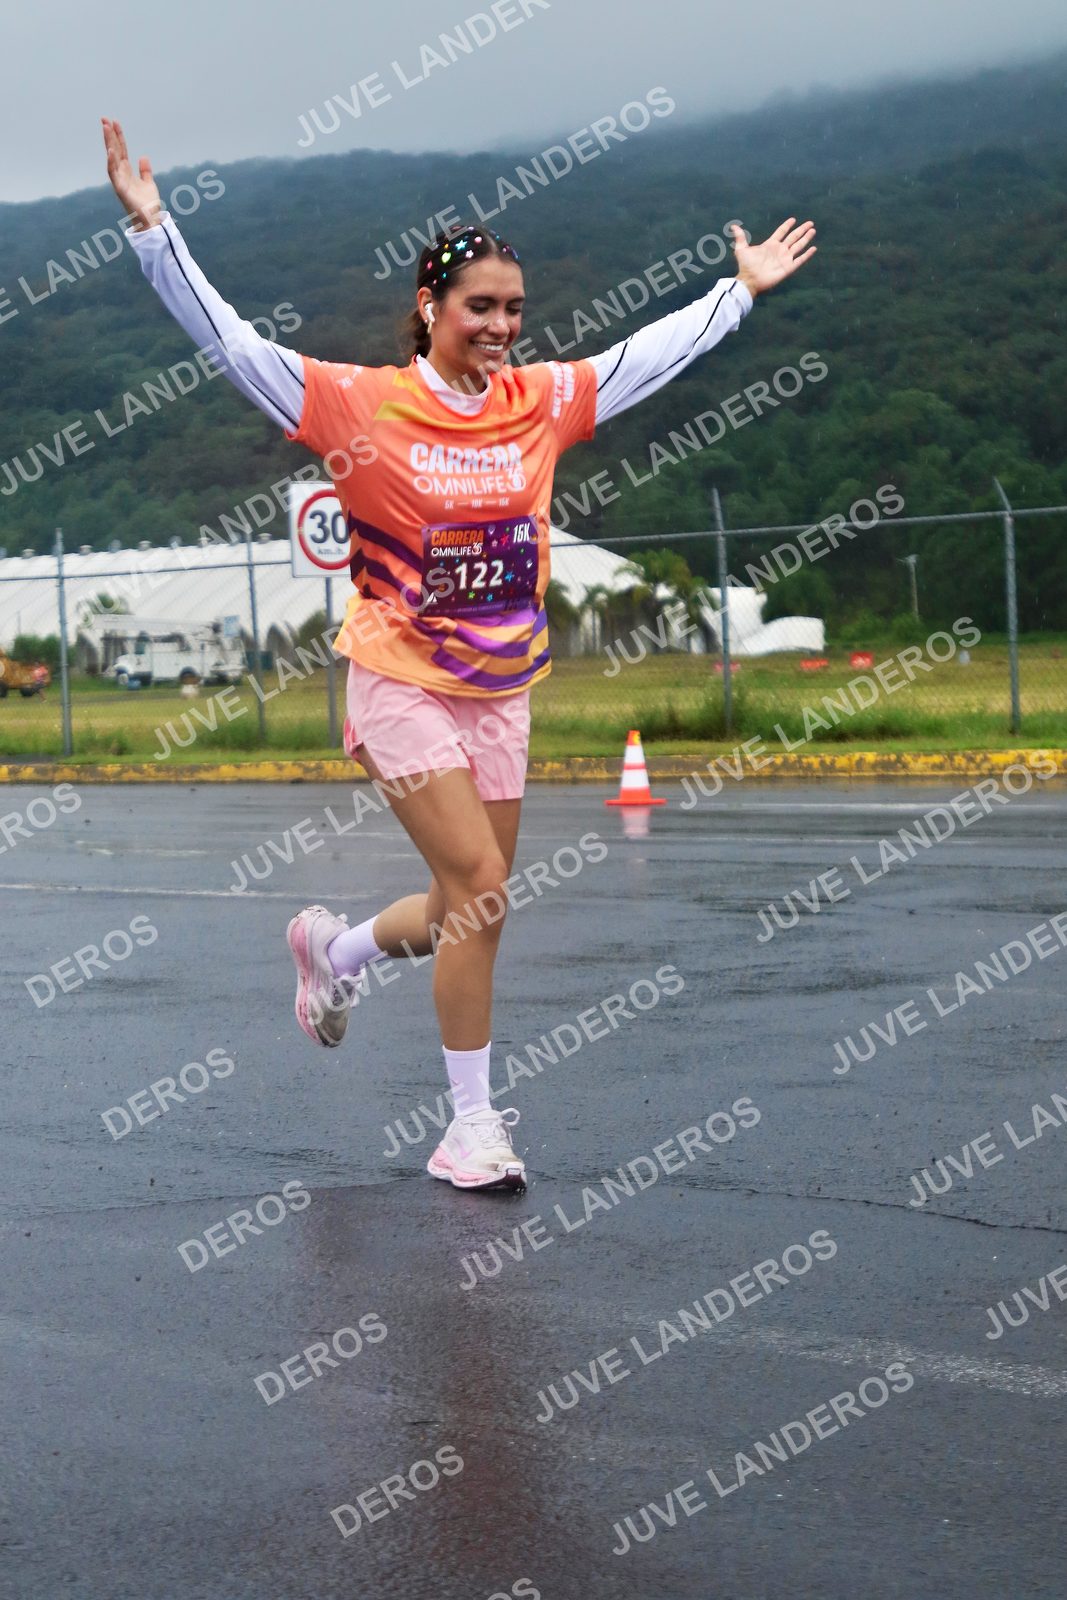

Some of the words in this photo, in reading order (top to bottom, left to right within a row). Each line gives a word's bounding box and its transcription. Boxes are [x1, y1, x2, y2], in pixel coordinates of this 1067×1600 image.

[410, 442, 522, 474] CARRERA
[309, 509, 350, 544] 30
[431, 530, 484, 546] CARRERA
[455, 559, 504, 590] 122
